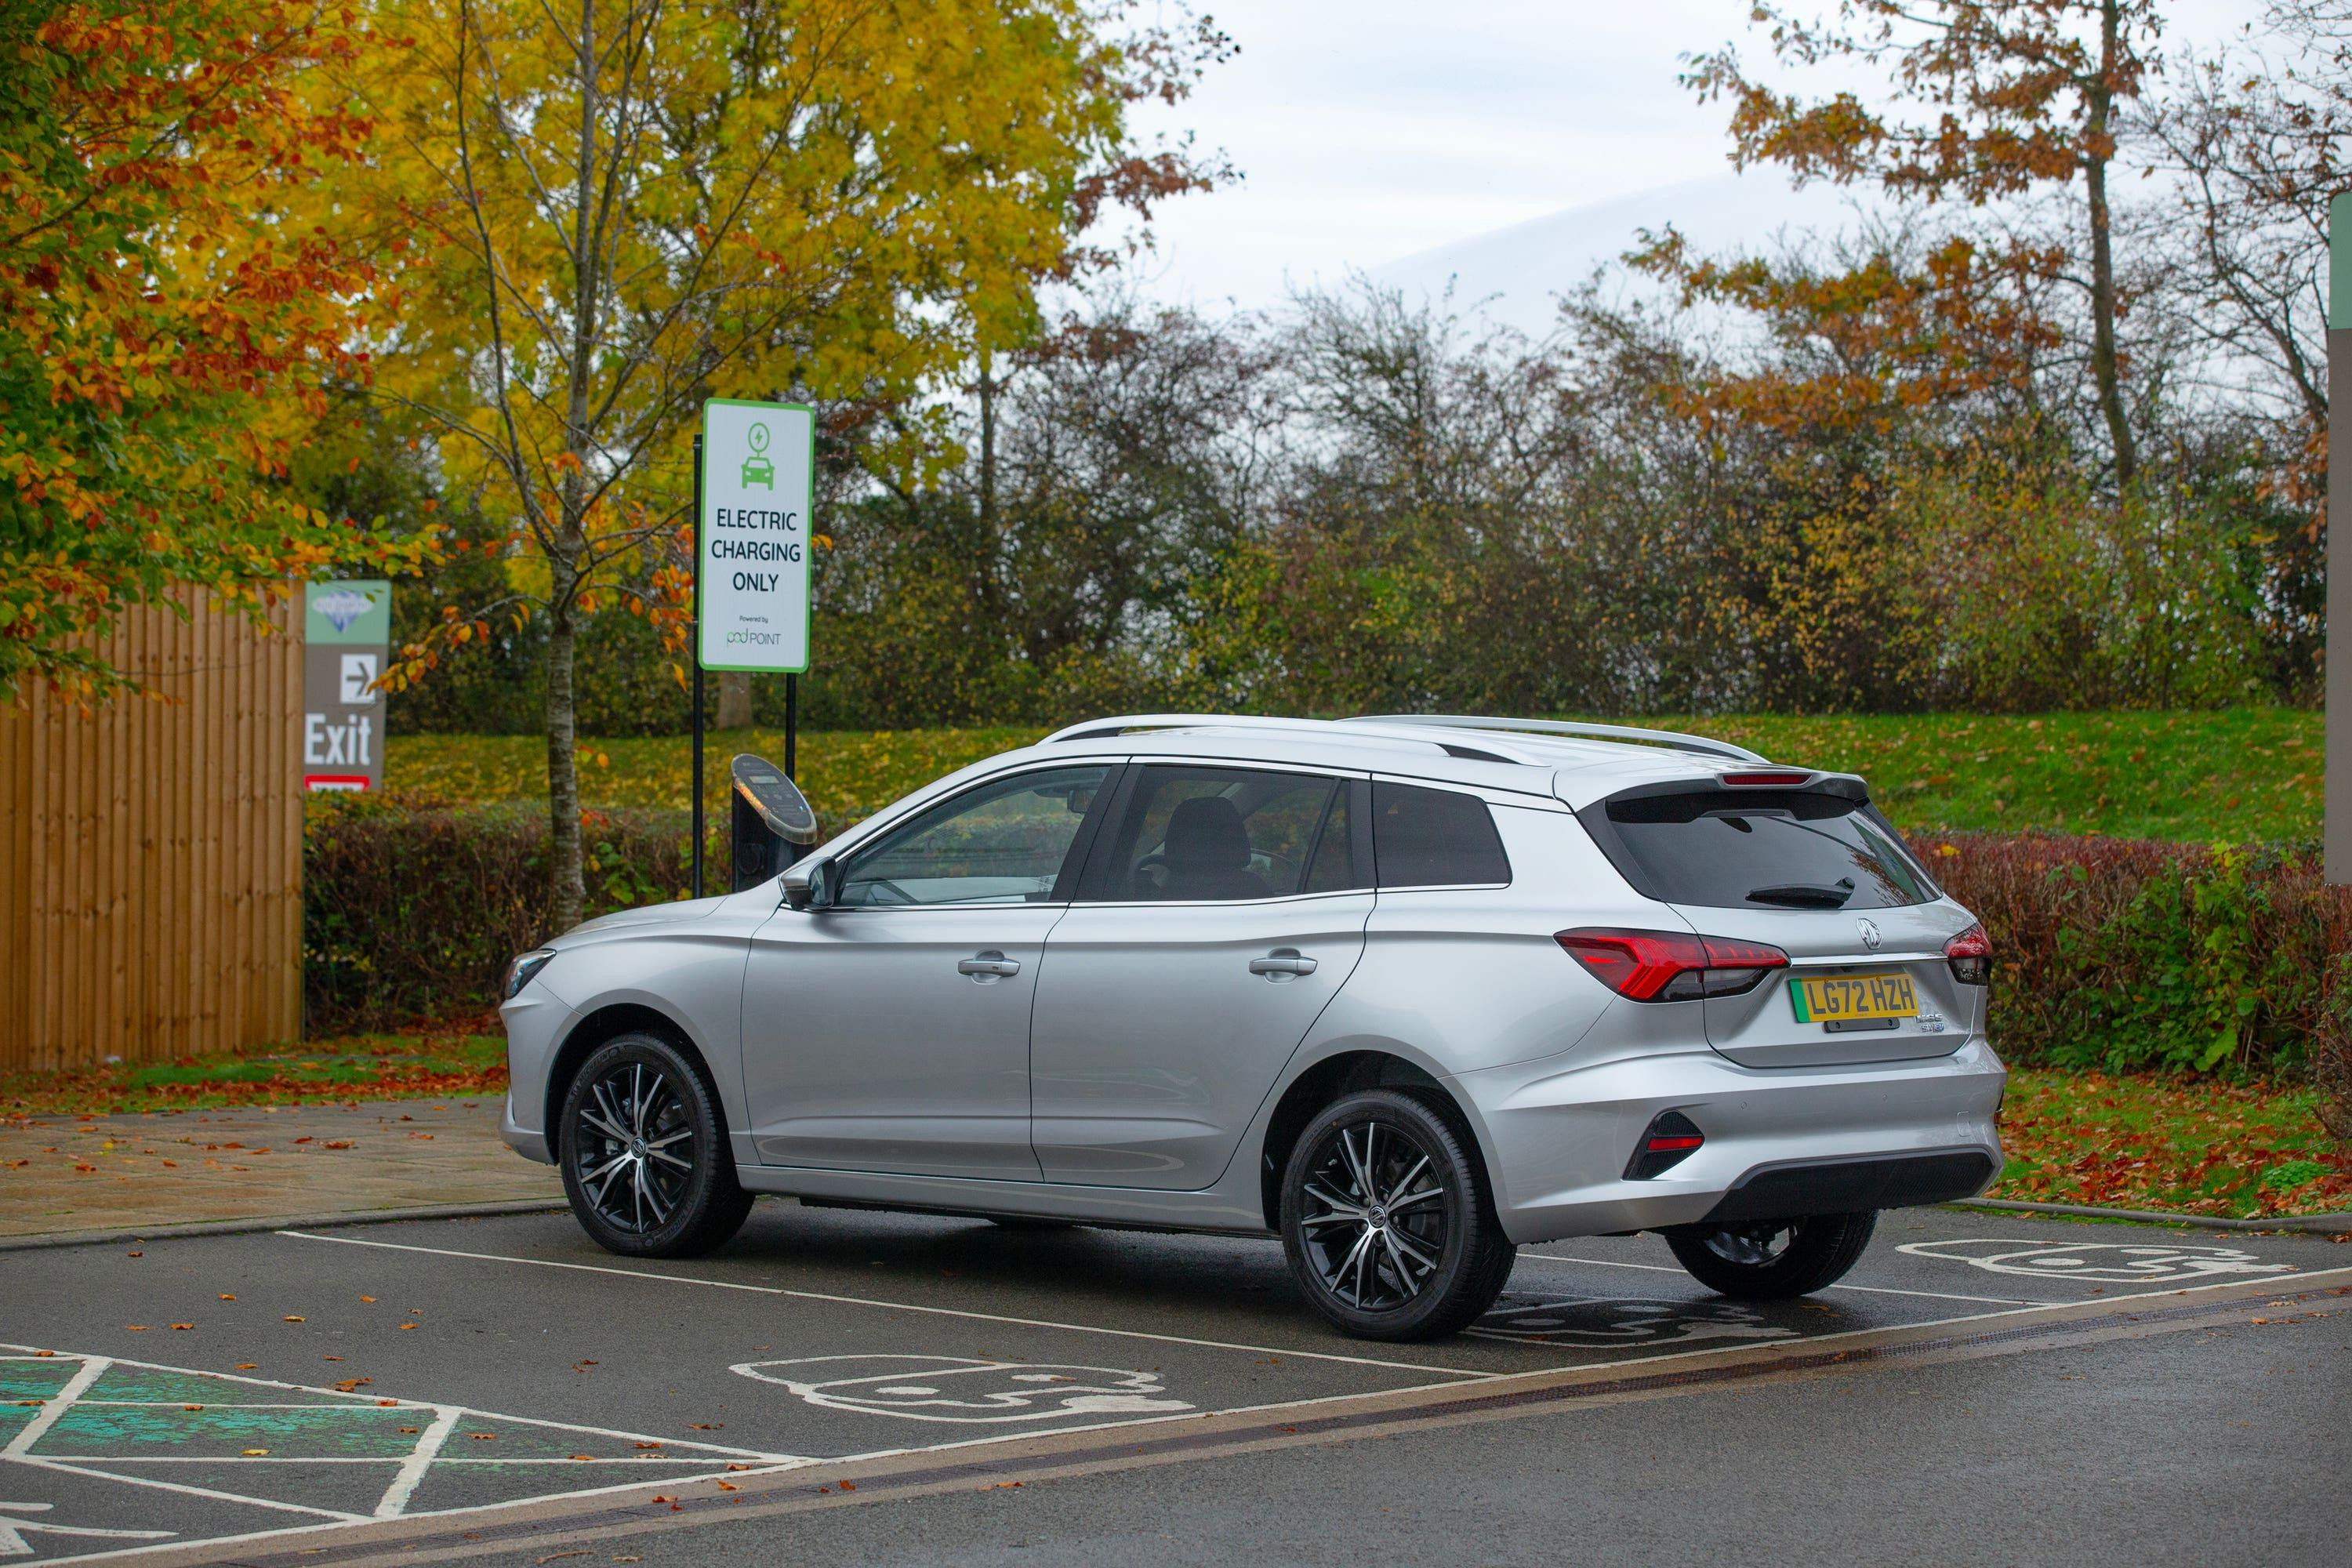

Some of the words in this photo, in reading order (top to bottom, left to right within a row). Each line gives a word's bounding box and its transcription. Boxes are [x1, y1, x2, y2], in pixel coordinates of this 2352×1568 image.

[717, 508, 797, 532] ELECTRIC
[711, 539, 800, 563] CHARGING
[732, 572, 779, 593] ONLY
[750, 632, 782, 644] POINT
[305, 713, 372, 765] Exit
[1807, 980, 1870, 1014] LG72
[1870, 978, 1915, 1011] HZH
